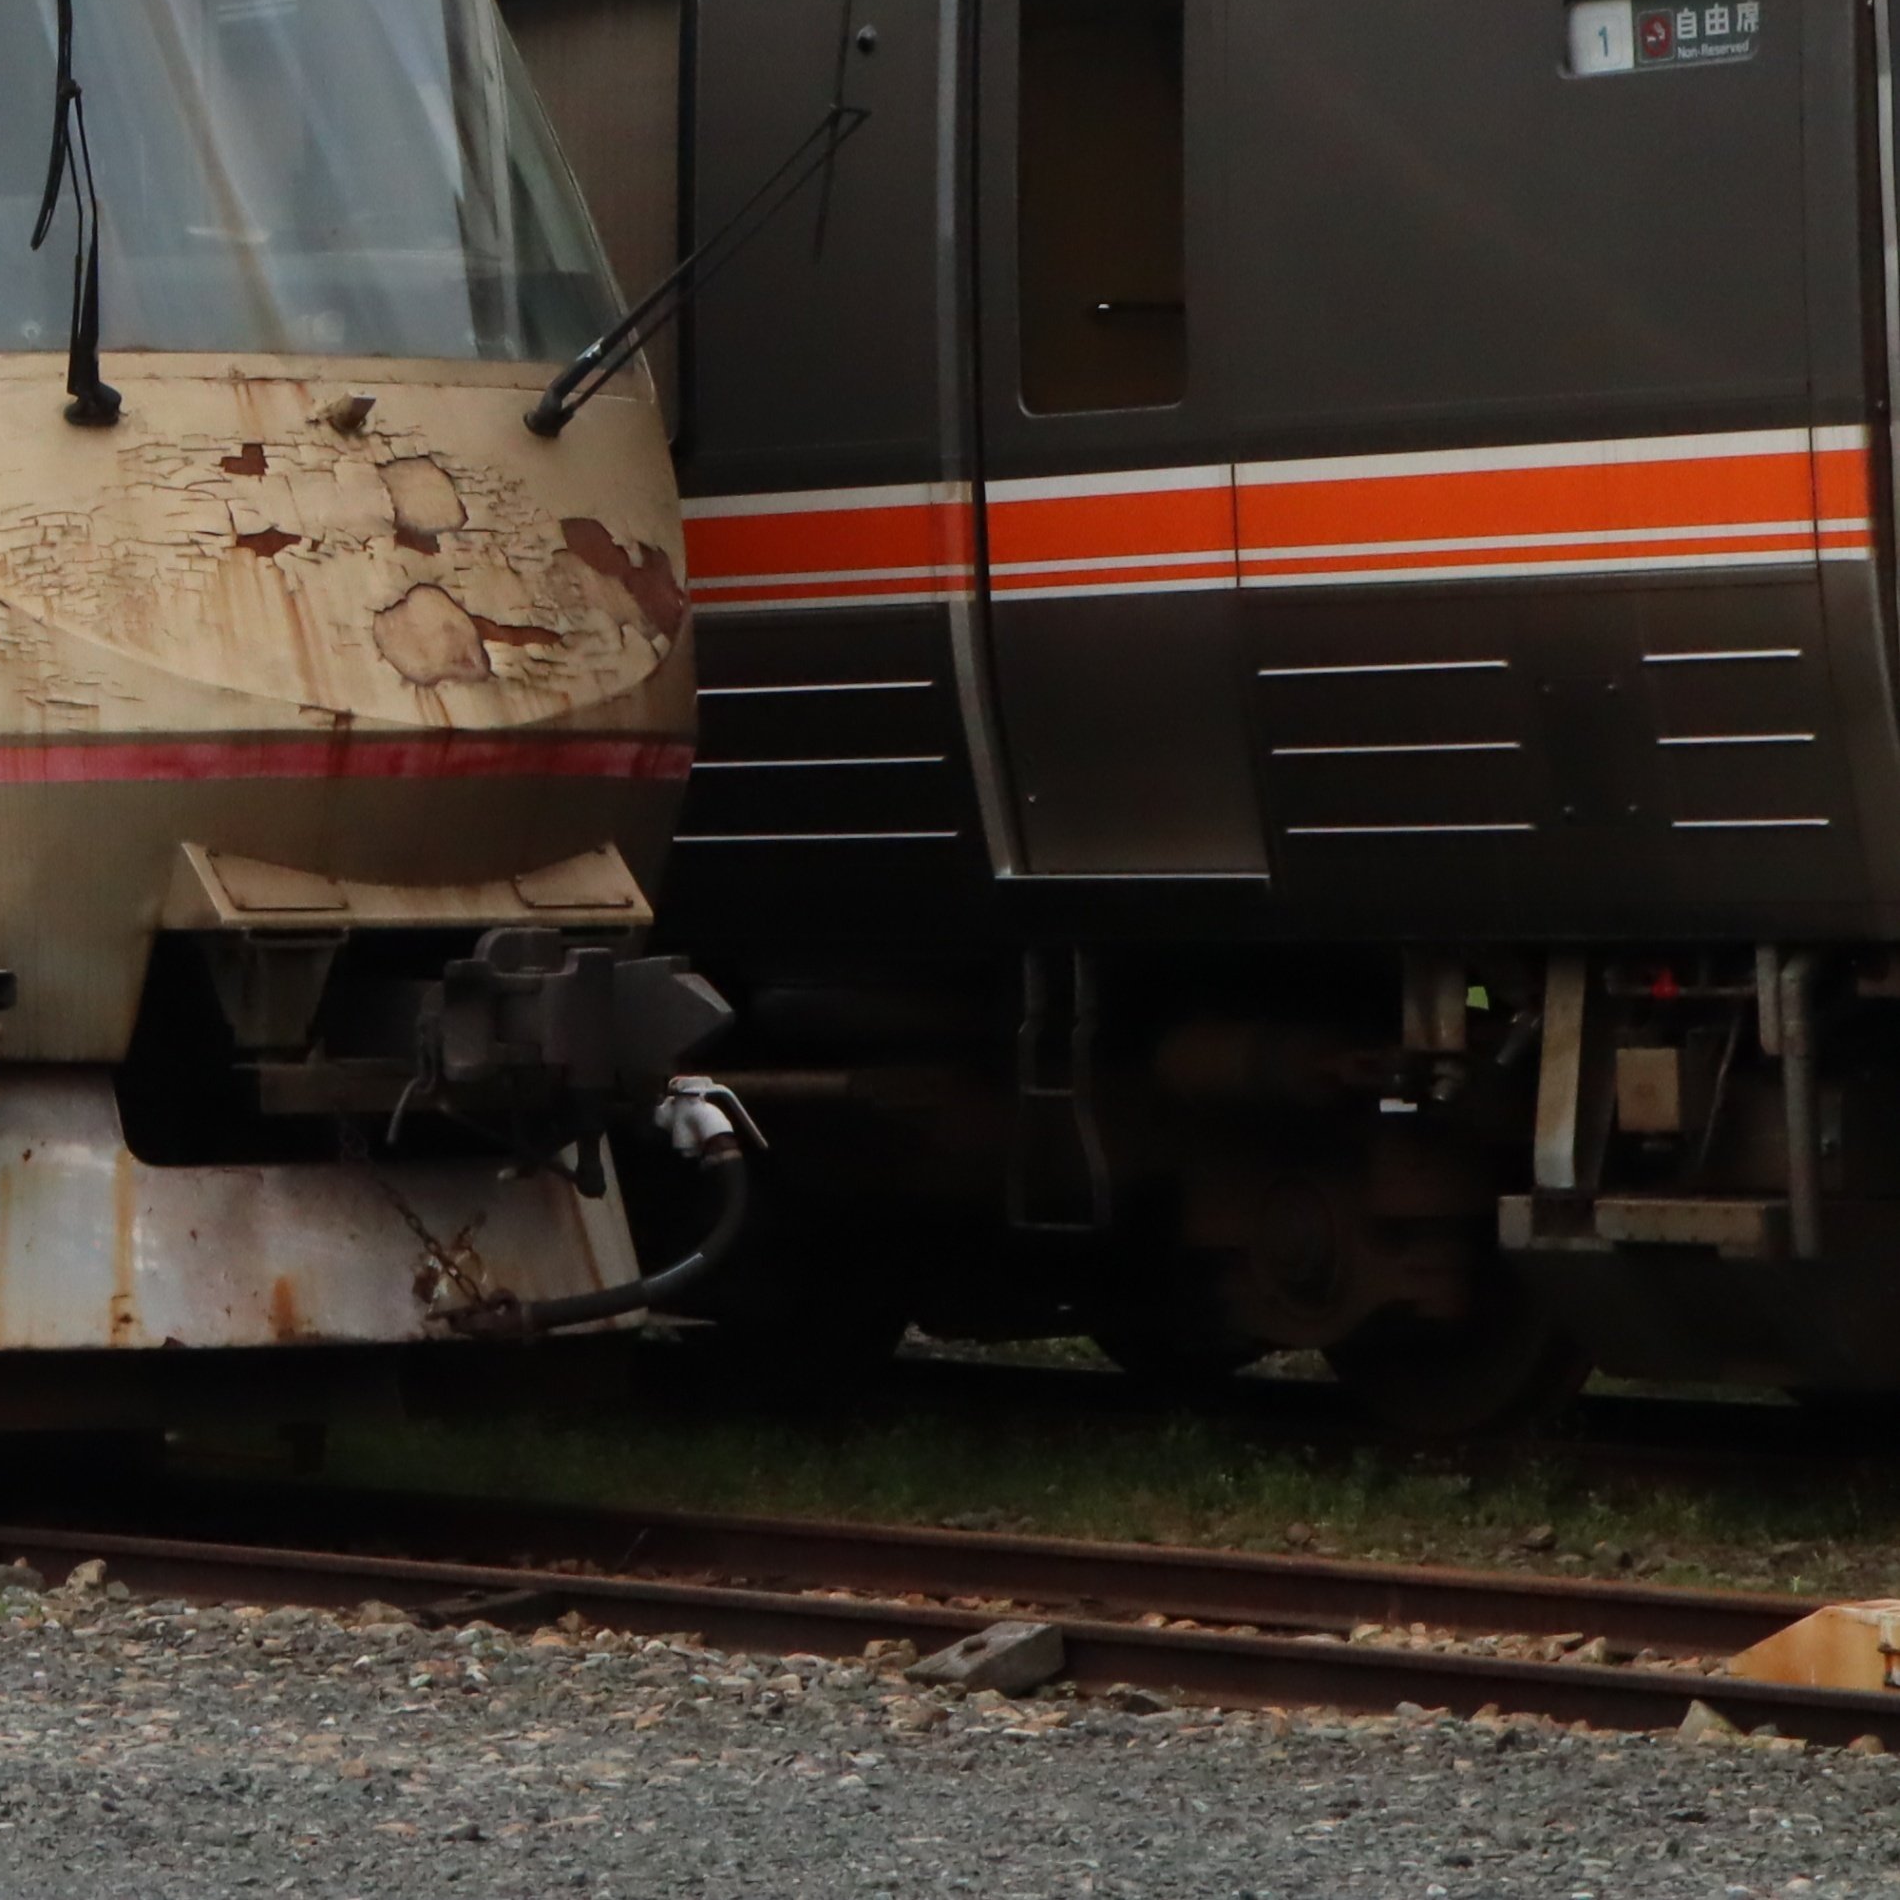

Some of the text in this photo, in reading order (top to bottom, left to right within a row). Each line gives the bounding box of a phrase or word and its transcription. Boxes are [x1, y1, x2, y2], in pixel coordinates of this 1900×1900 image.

[1676, 0, 1760, 40] 自由席
[1597, 26, 1609, 58] 1
[1677, 38, 1750, 59] Non-Reserved
